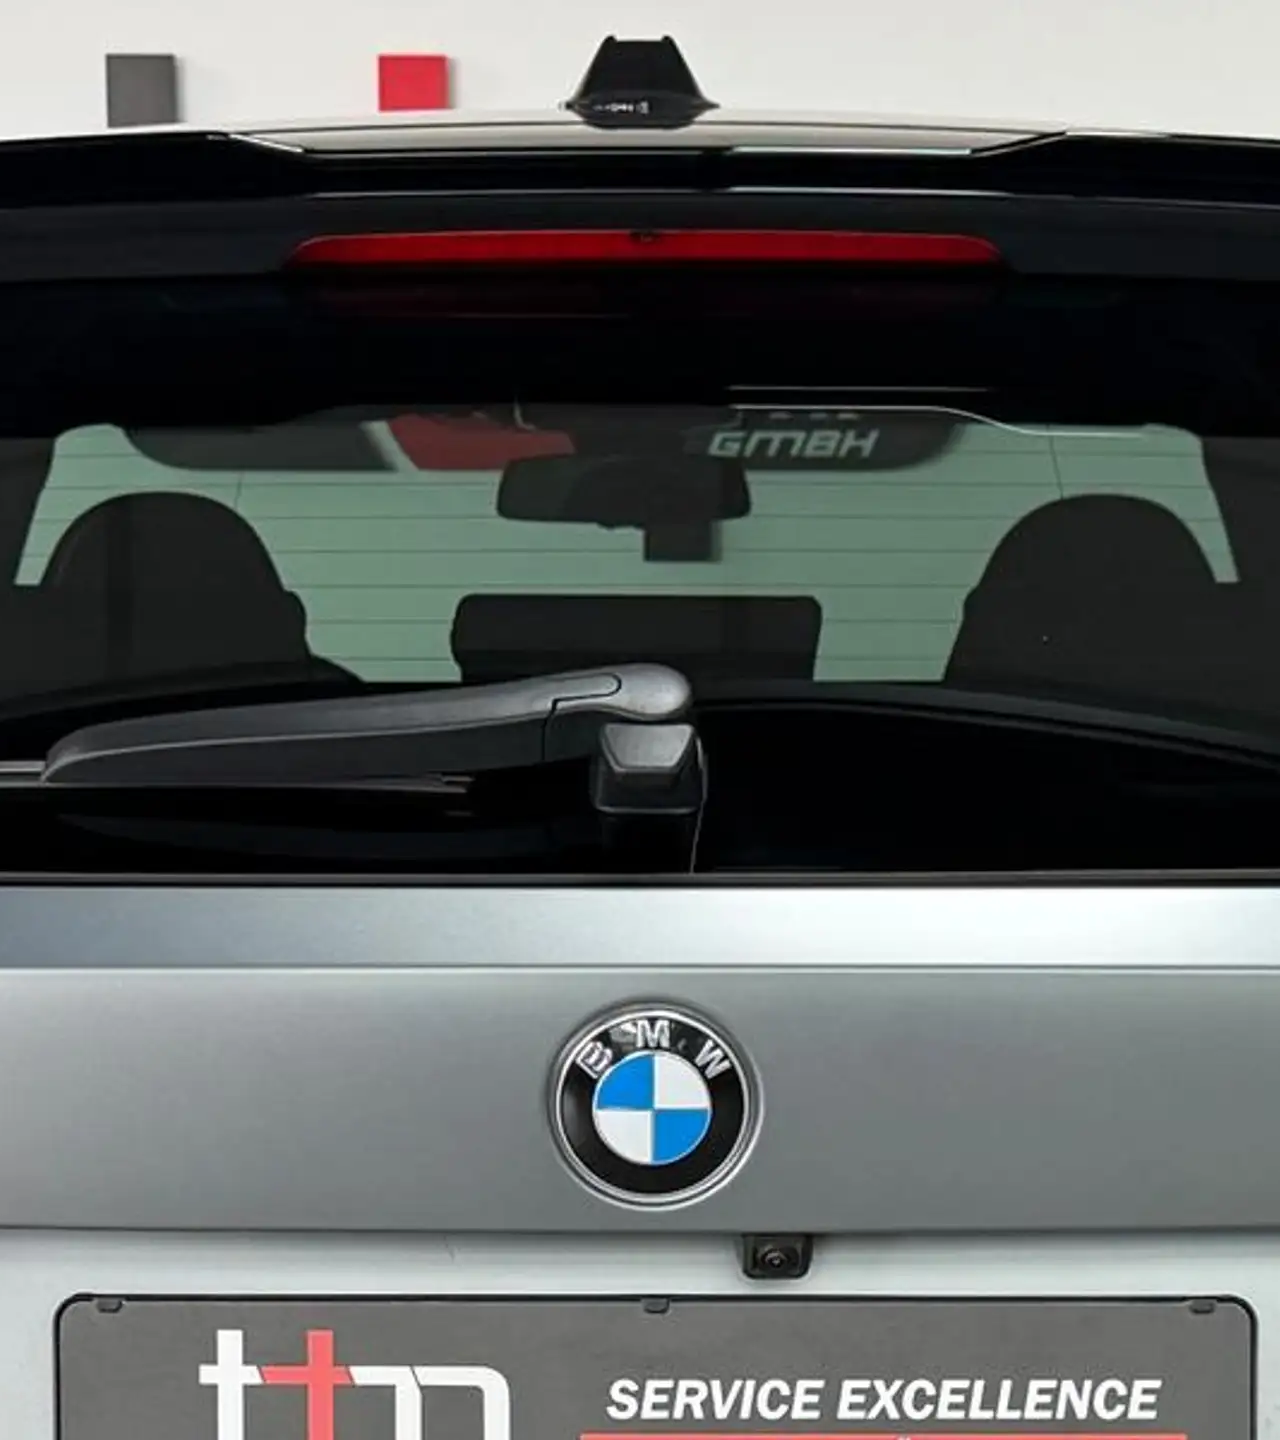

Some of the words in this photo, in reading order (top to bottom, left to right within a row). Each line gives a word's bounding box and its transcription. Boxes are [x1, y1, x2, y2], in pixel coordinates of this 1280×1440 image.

[575, 1018, 733, 1081] BMW
[606, 1379, 825, 1420] SERVICE
[836, 1379, 1163, 1420] EXCELLENCE
